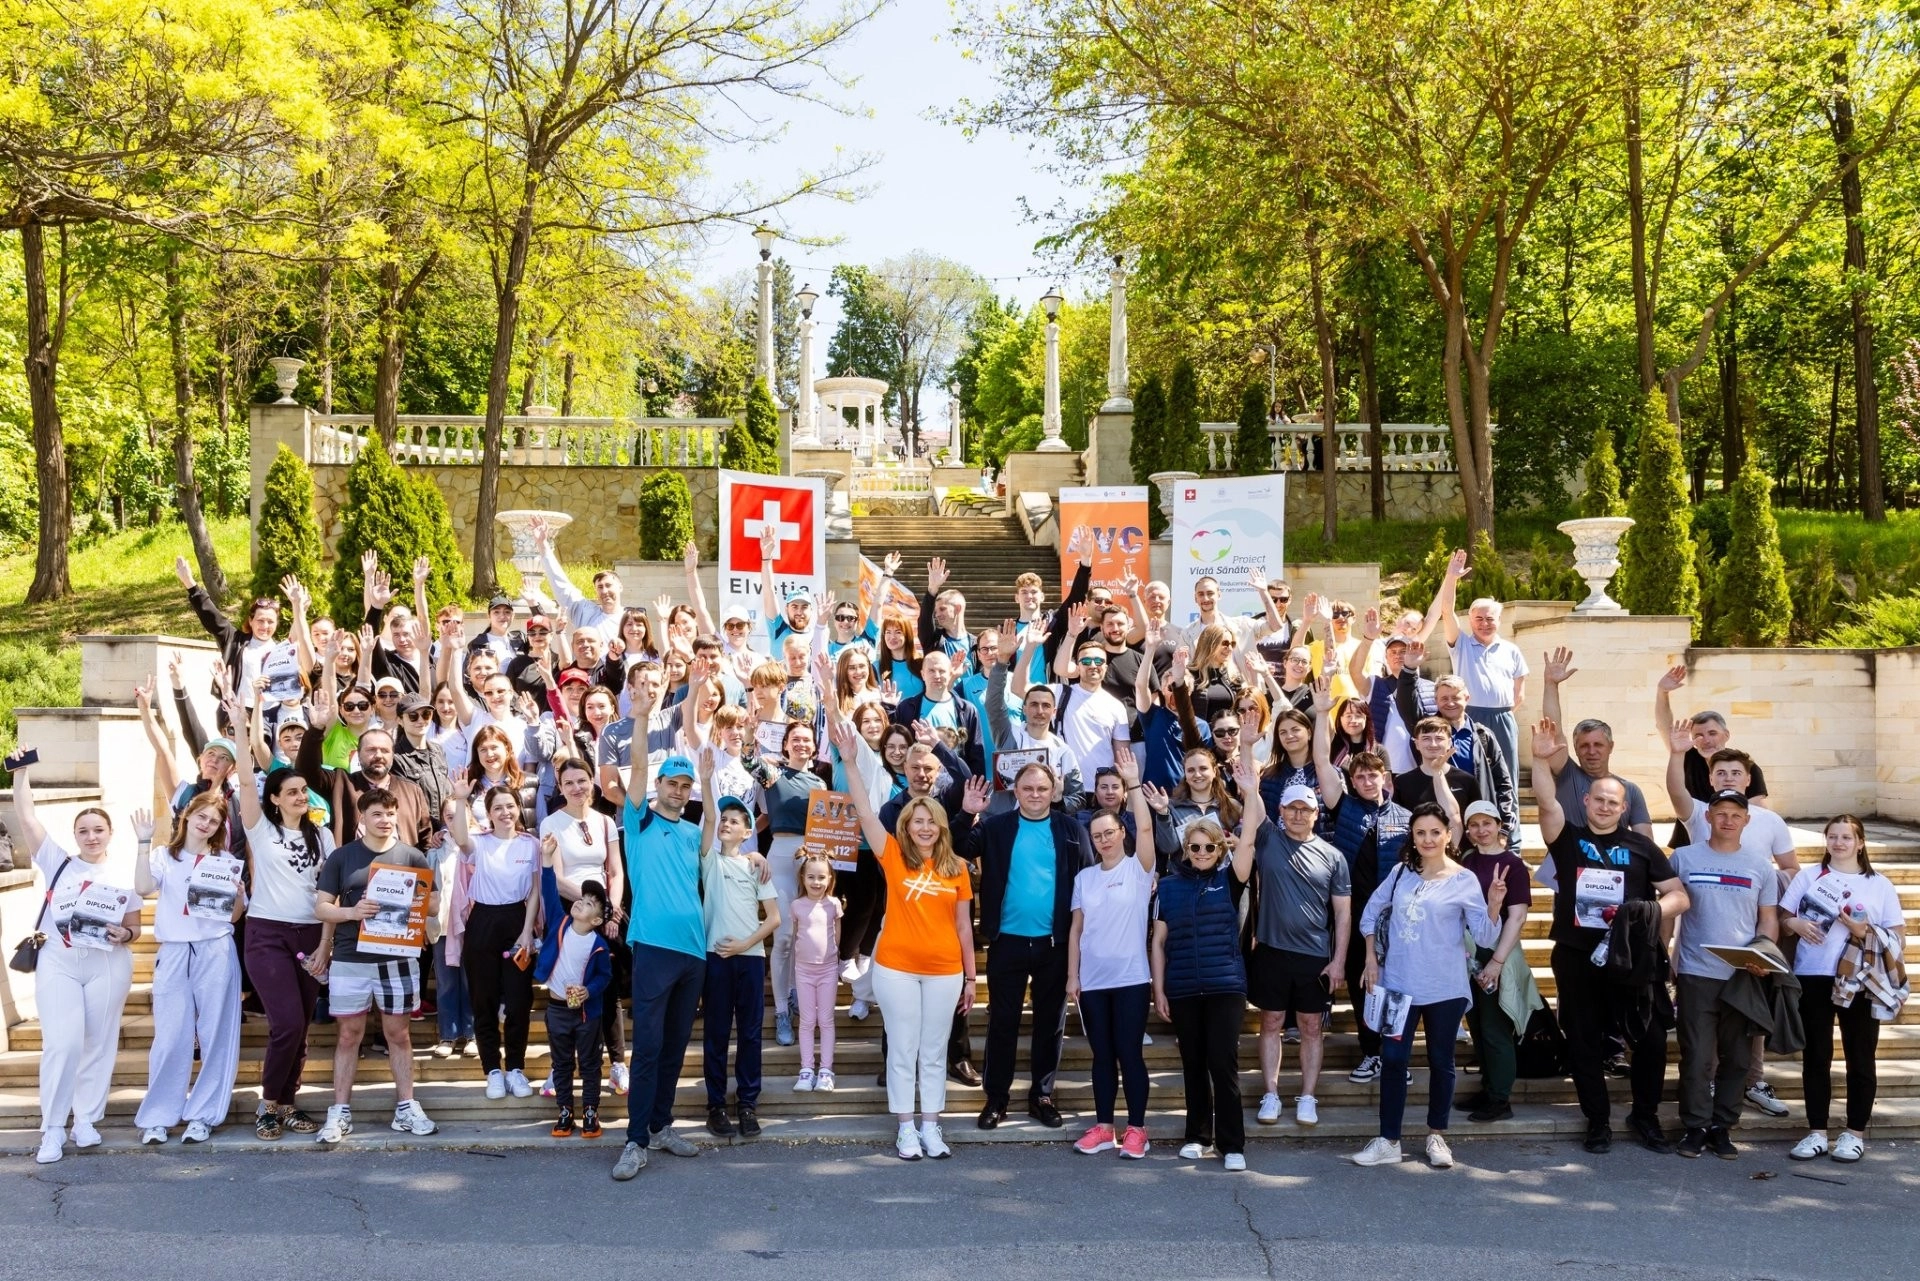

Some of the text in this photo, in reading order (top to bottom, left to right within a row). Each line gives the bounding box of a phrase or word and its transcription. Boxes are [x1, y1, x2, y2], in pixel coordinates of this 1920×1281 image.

[834, 845, 850, 857] 112
[1703, 867, 1738, 875] TOMMY
[201, 872, 231, 882] DIPLOMĂ
[376, 886, 405, 896] DIPLOMĂ
[1585, 883, 1615, 891] DIPLOMĂ
[1698, 884, 1741, 893] HILFIGER
[1817, 886, 1840, 903] DIPLOMĂ
[86, 899, 116, 912] DIPLOMĂ
